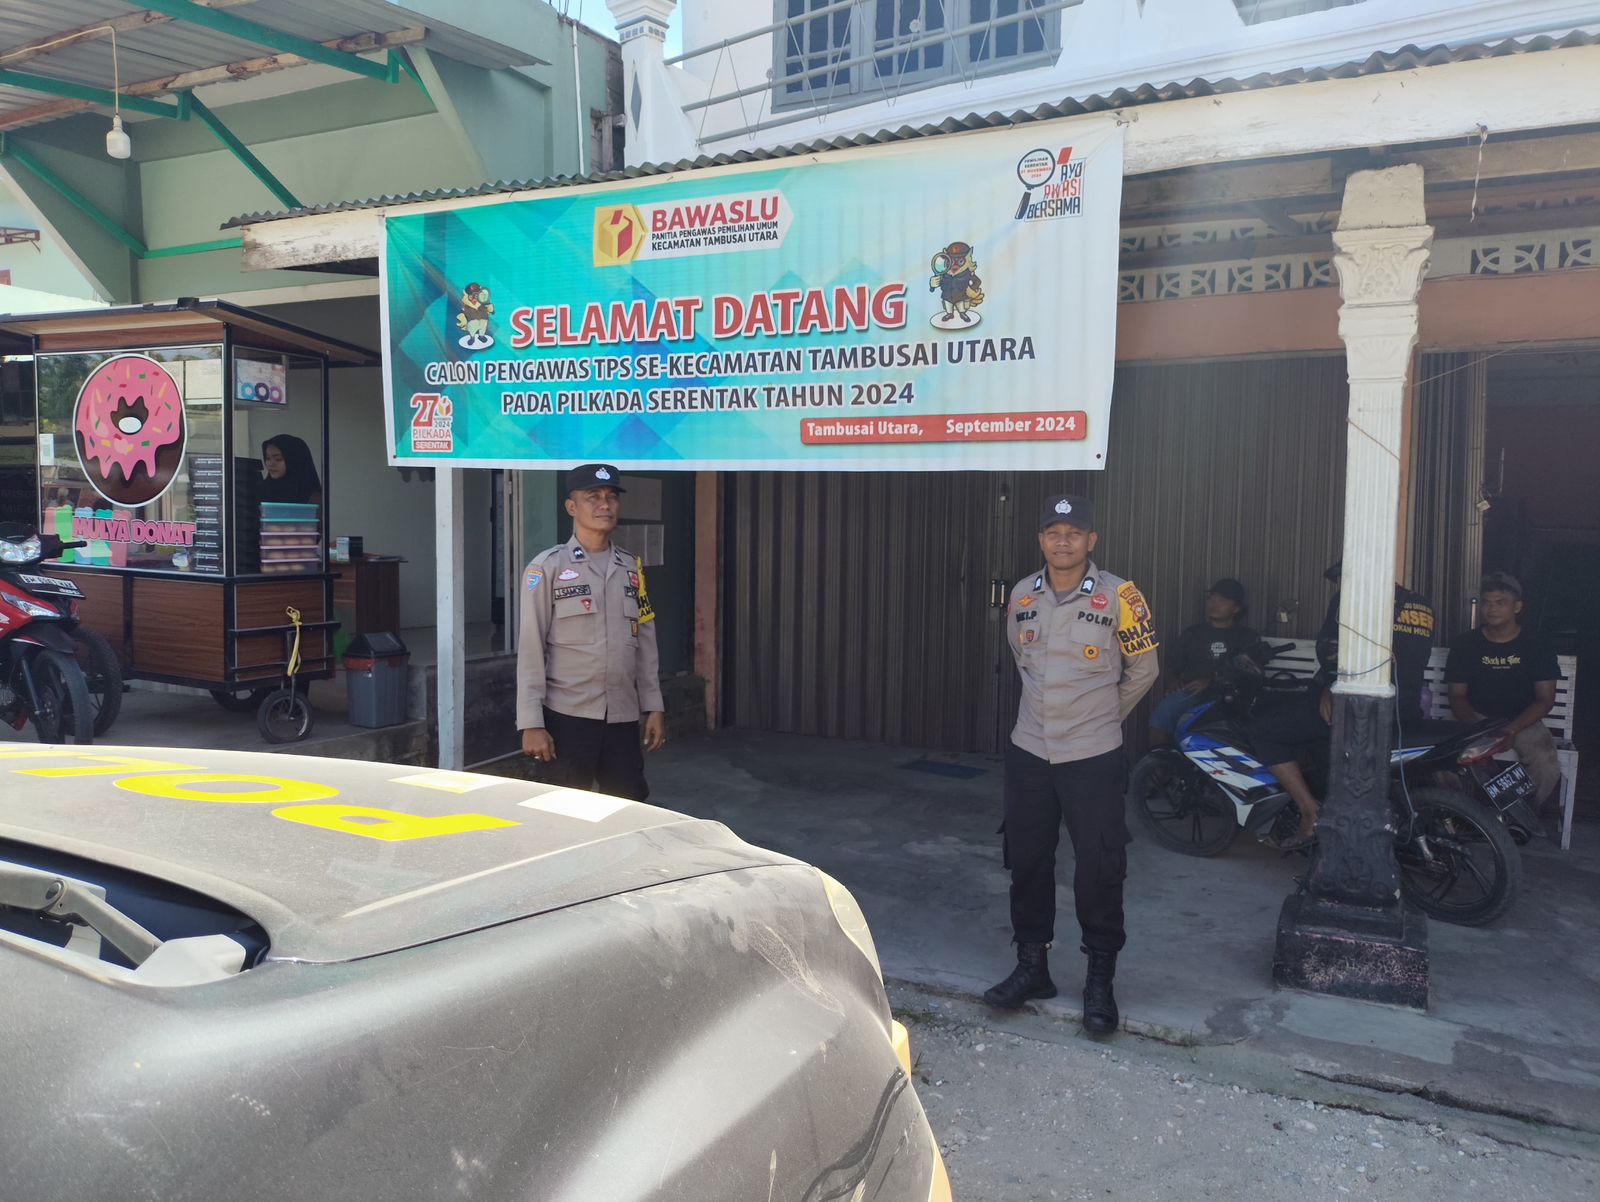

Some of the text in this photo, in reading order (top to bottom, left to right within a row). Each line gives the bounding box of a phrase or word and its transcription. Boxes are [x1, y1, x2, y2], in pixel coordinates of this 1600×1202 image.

[1061, 162, 1083, 181] AYO
[1044, 178, 1081, 199] AWASI
[652, 196, 779, 232] BAWASLU
[1027, 196, 1081, 219] BERSAMA
[652, 221, 778, 241] PANITIA PENGAWAS PEMILIHAN UMUM
[652, 230, 778, 251] KECAMATAN TAMBUSAI UTARA
[511, 283, 905, 345] SELAMAT DATANG
[427, 336, 1036, 383] CALON PENGAWAS TPS SE-KECAMATAN TAMBUSAI UTARA
[503, 382, 915, 413] PADA PILKADA SERENTAK TAHUN 2024
[411, 395, 440, 427] 27
[413, 429, 451, 439] PILKADA
[807, 416, 1076, 437] Tambusai Utara, September 2024
[415, 441, 449, 449] SERENTAK
[72, 517, 197, 546] MULYA DONAT
[1077, 611, 1113, 627] POLRI
[1398, 610, 1434, 631] NSER
